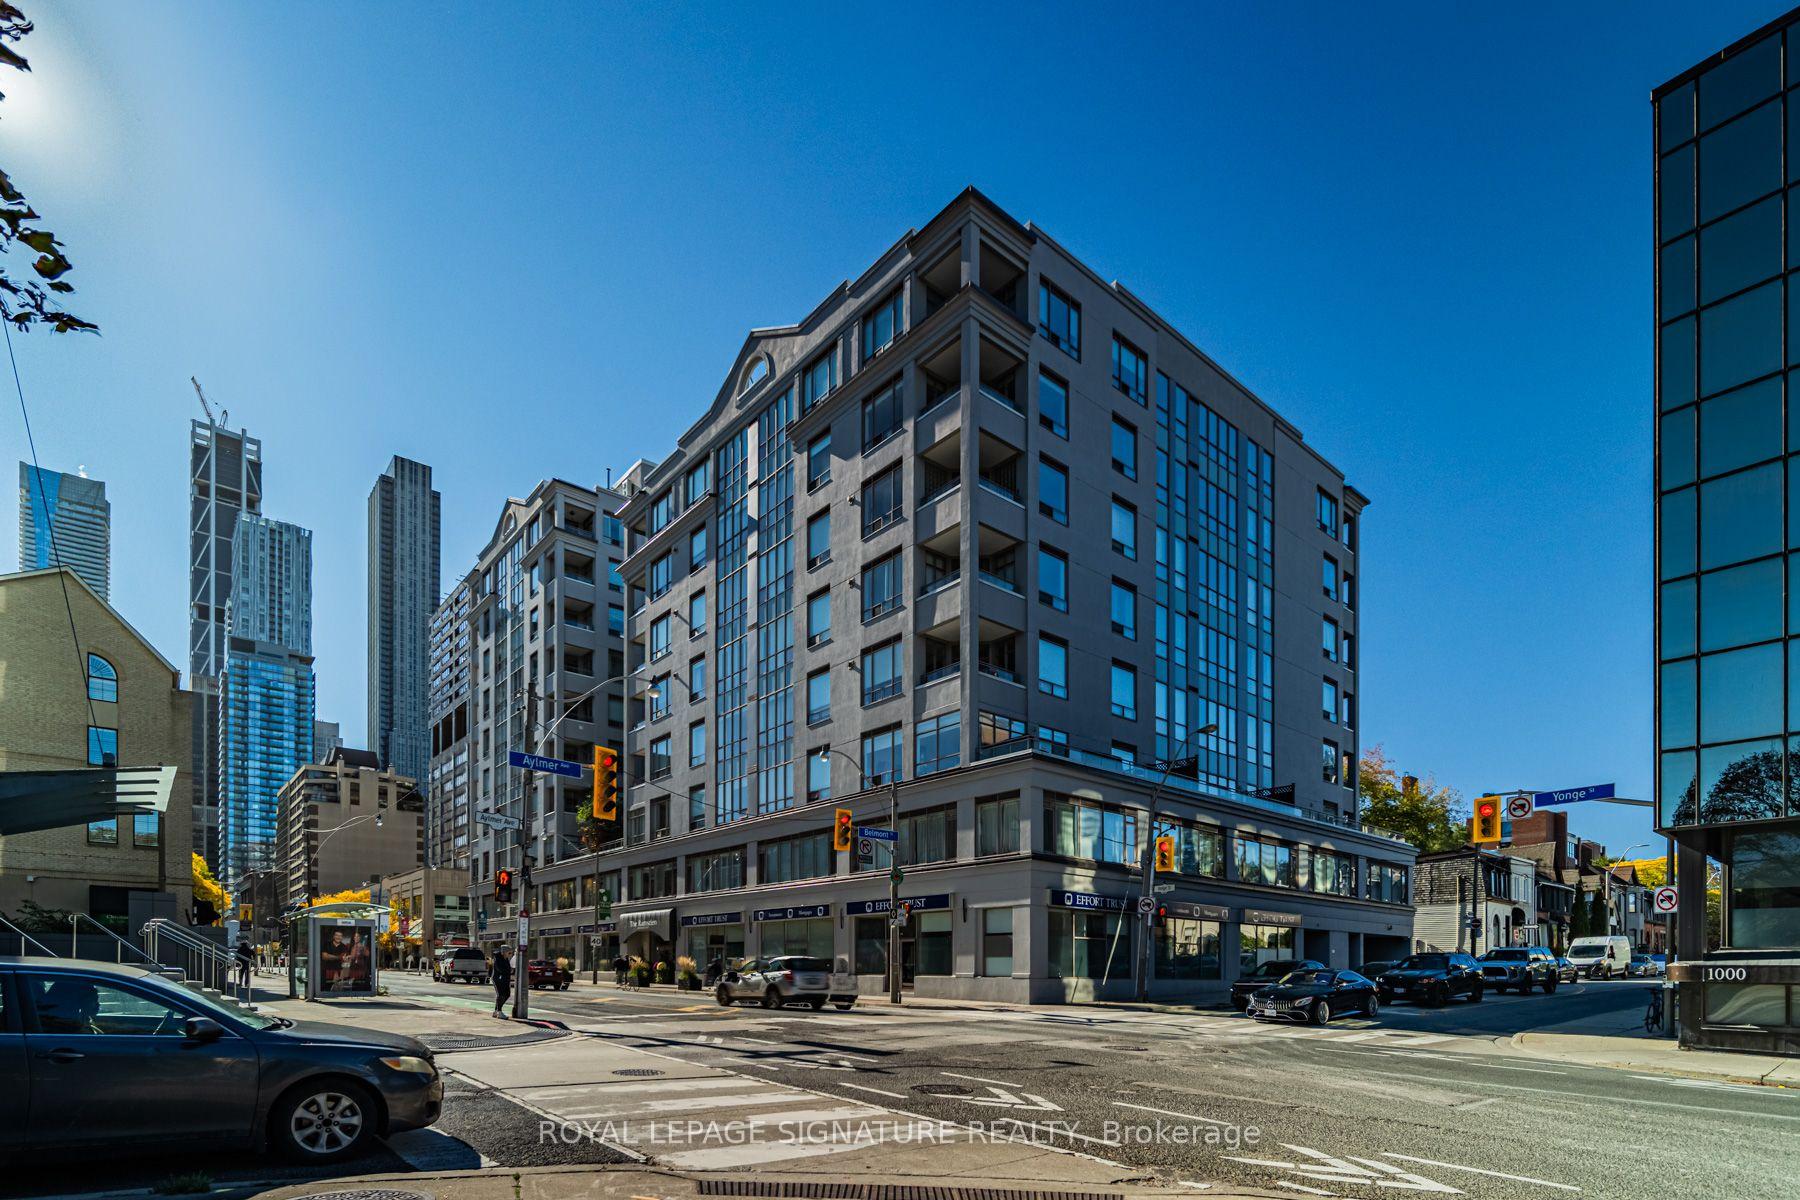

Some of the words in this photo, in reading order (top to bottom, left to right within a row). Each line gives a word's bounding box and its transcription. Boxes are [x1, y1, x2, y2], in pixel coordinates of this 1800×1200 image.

[523, 755, 559, 770] Aylmer
[1552, 790, 1586, 802] Yonge
[480, 814, 502, 824] Aylmer
[504, 818, 516, 826] Ave
[864, 829, 889, 838] Belmont
[1076, 894, 1104, 907] EFFORT
[629, 920, 638, 928] The
[1707, 967, 1747, 980] 1000
